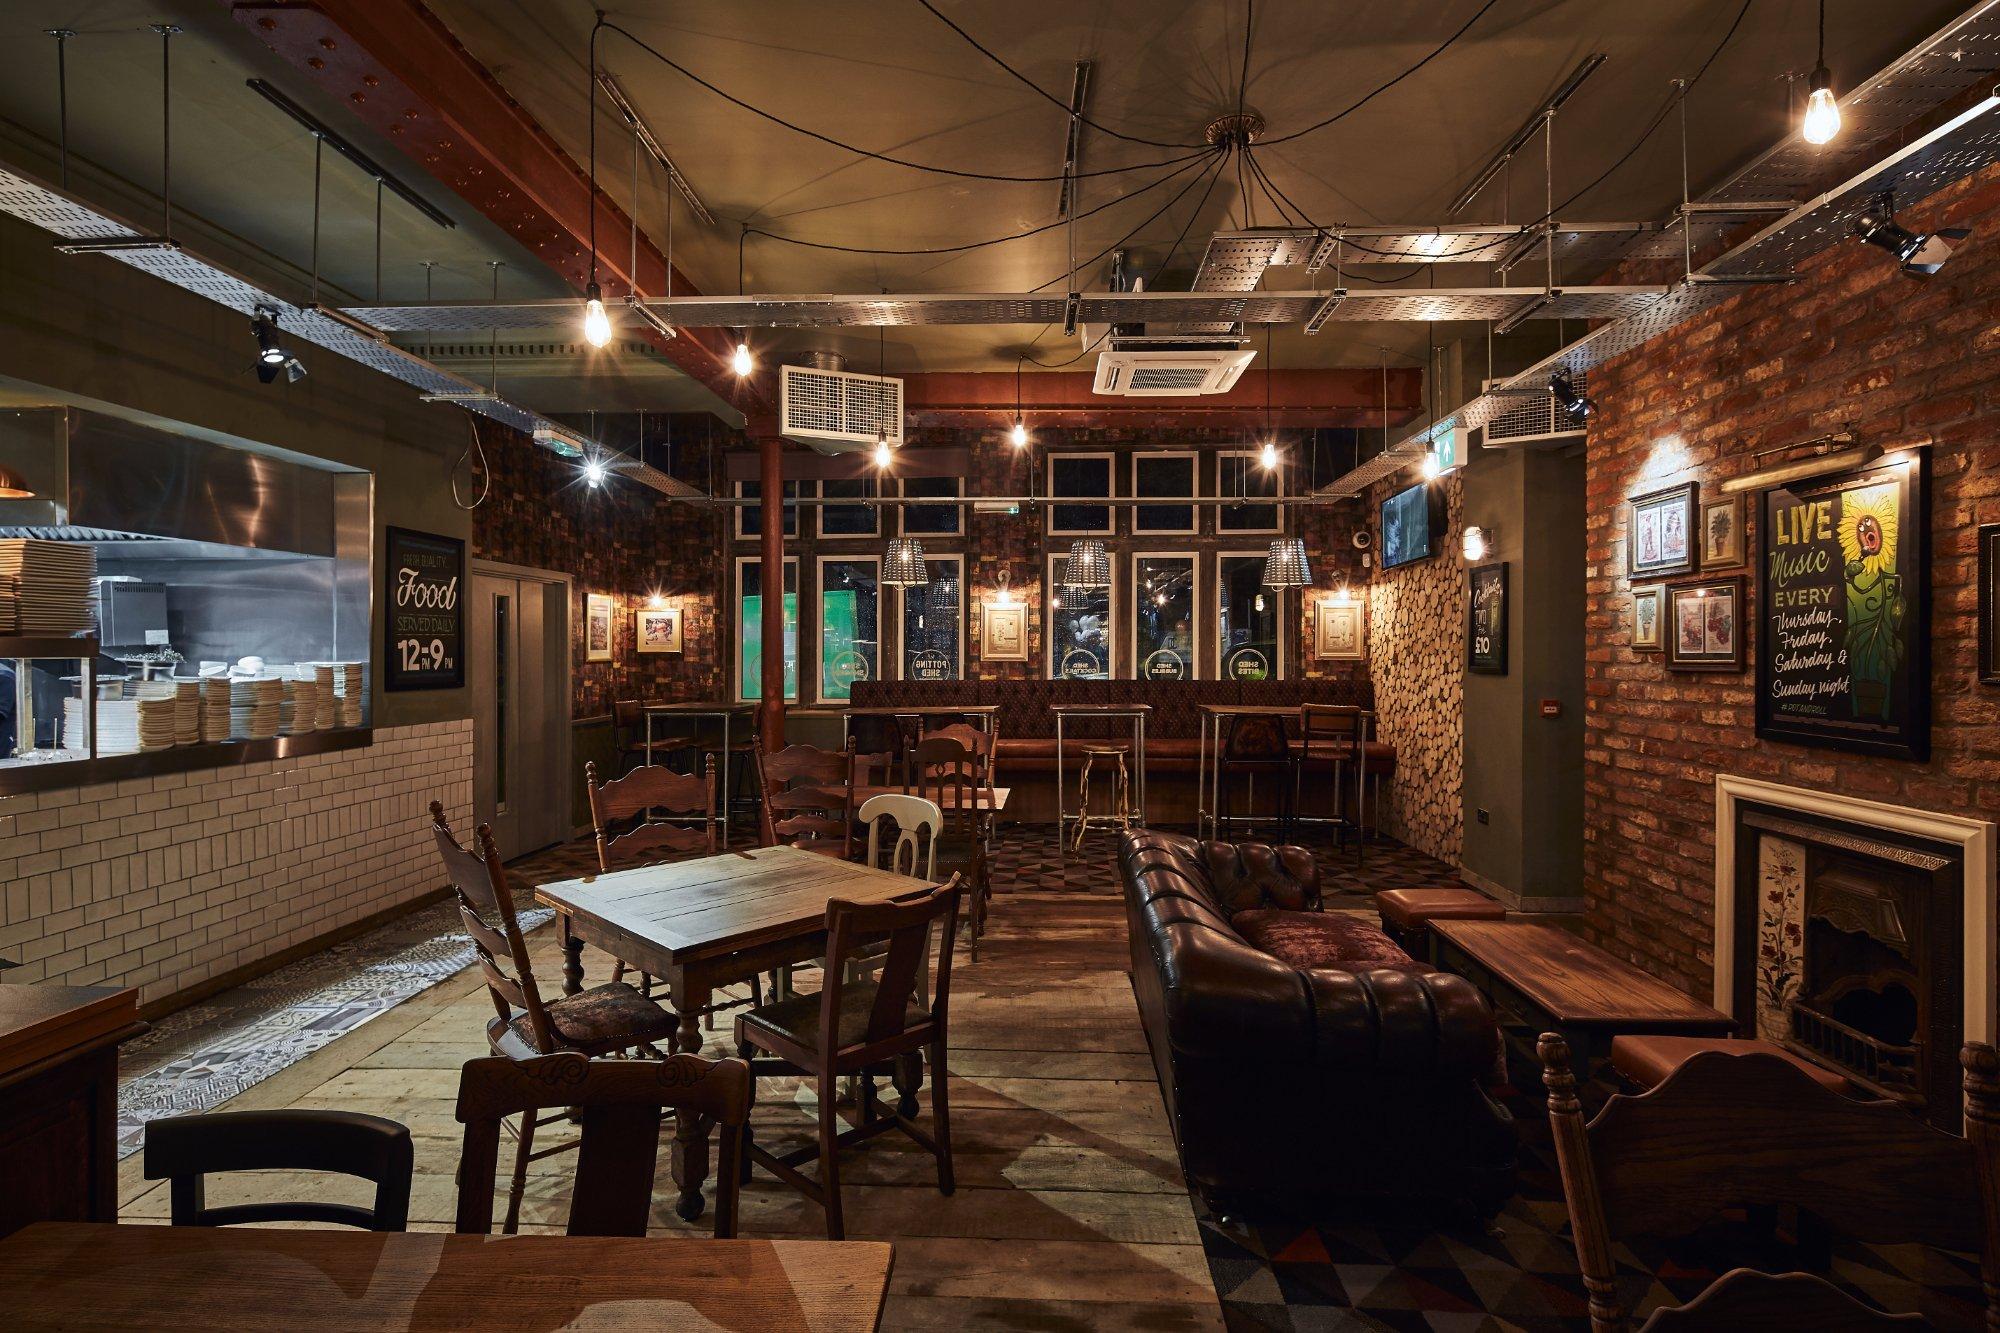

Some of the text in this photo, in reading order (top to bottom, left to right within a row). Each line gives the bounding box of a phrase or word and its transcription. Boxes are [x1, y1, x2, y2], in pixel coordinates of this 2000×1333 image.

[1776, 501, 1832, 545] LIVE
[1769, 547, 1830, 587] Music
[397, 567, 457, 610] Food
[1775, 587, 1834, 608] EVERY
[397, 616, 456, 632] SERVED DAILY
[1475, 636, 1490, 654] £10
[1774, 649, 1848, 673] Saturday &
[1772, 675, 1850, 700] Sunday night
